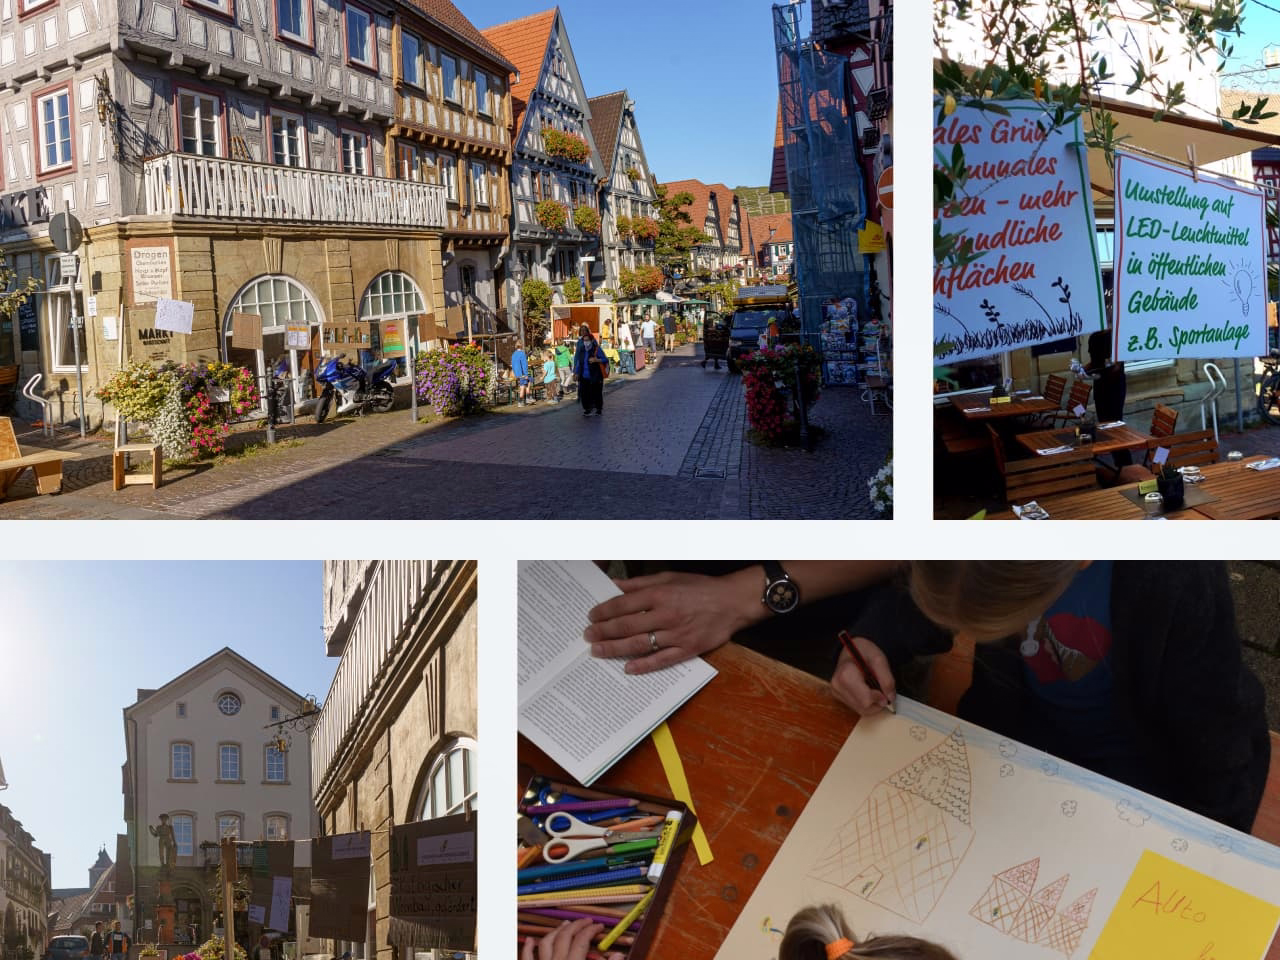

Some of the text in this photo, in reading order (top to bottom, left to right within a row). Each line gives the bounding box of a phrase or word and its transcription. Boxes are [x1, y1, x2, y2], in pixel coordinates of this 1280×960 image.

[1019, 180, 1078, 211] mehr
[1125, 179, 1235, 220] Umstellung auf
[1126, 216, 1250, 246] LED-Leuchtmittel
[133, 250, 168, 260] Drogen
[1127, 251, 1226, 281] in öffentlichen
[1127, 287, 1198, 314] Gebäude
[1127, 320, 1250, 355] z.B. Sportanlage
